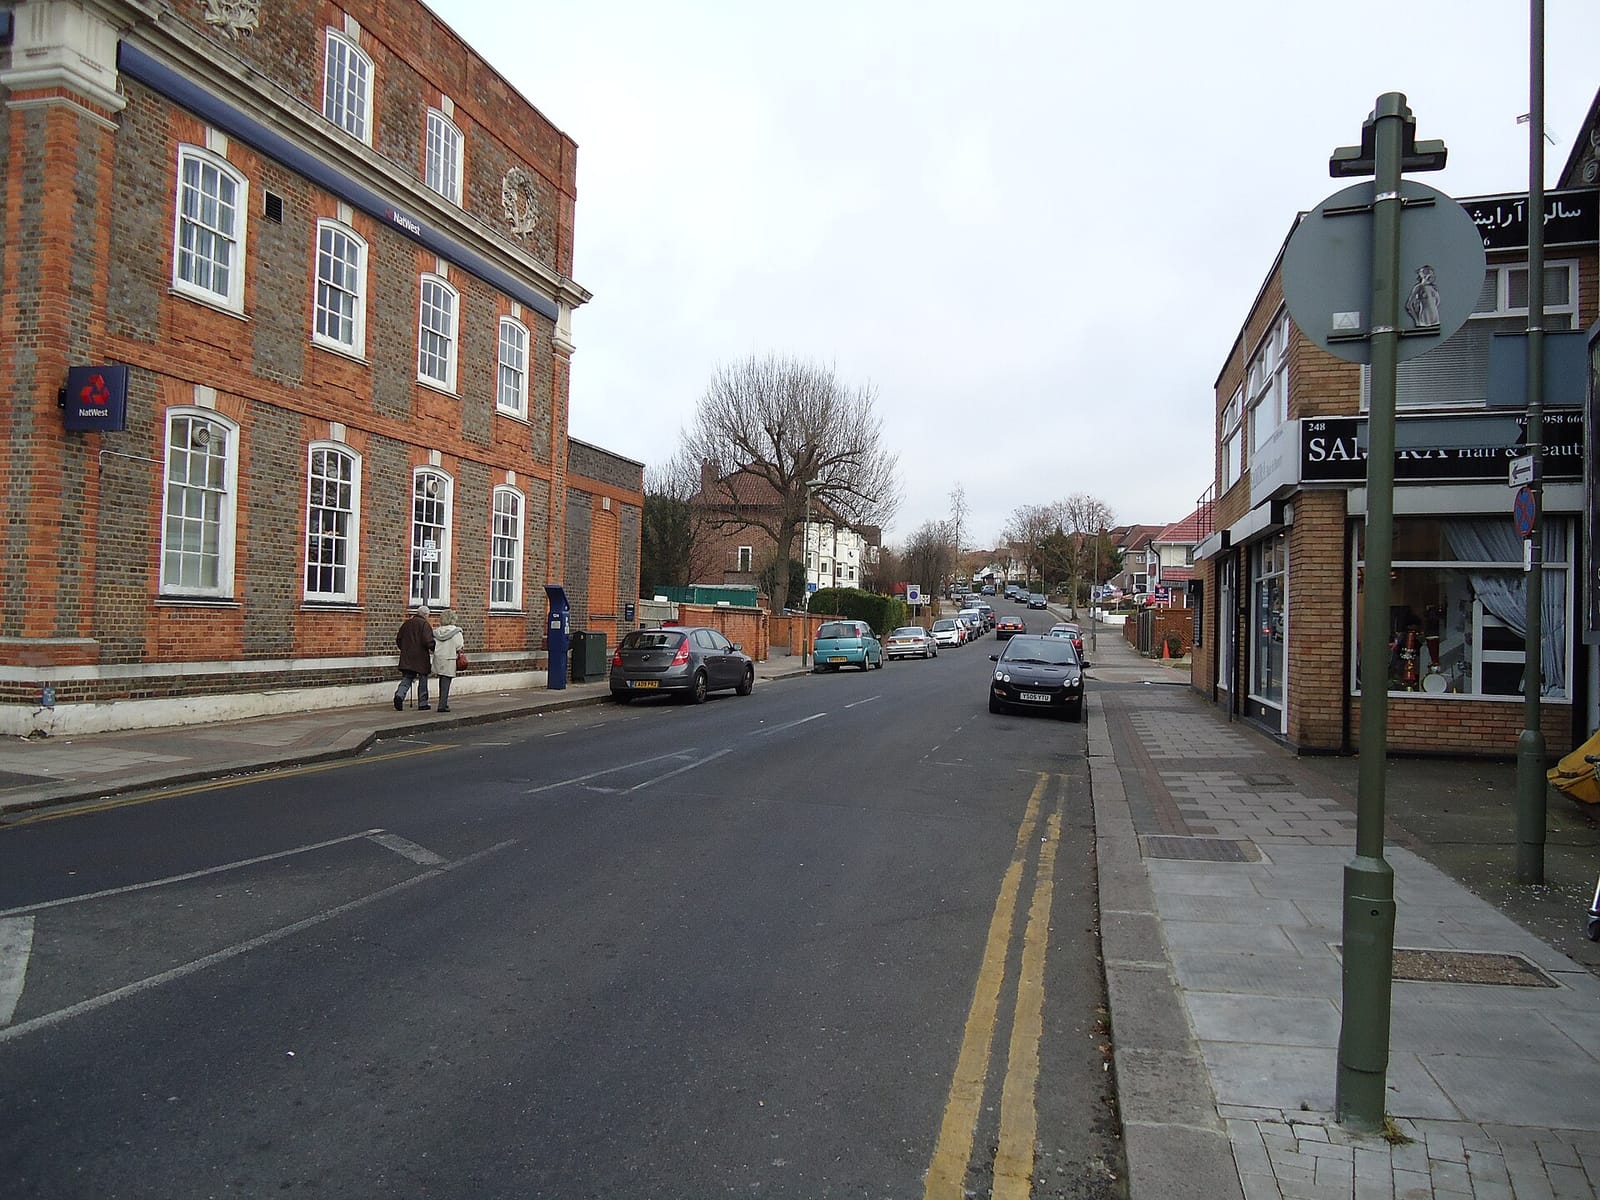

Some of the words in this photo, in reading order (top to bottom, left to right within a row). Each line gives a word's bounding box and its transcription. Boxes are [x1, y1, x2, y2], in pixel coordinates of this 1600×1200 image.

[393, 211, 421, 237] NatWest
[79, 408, 108, 417] NatWest
[1308, 423, 1326, 431] 248
[1505, 448, 1520, 457] &
